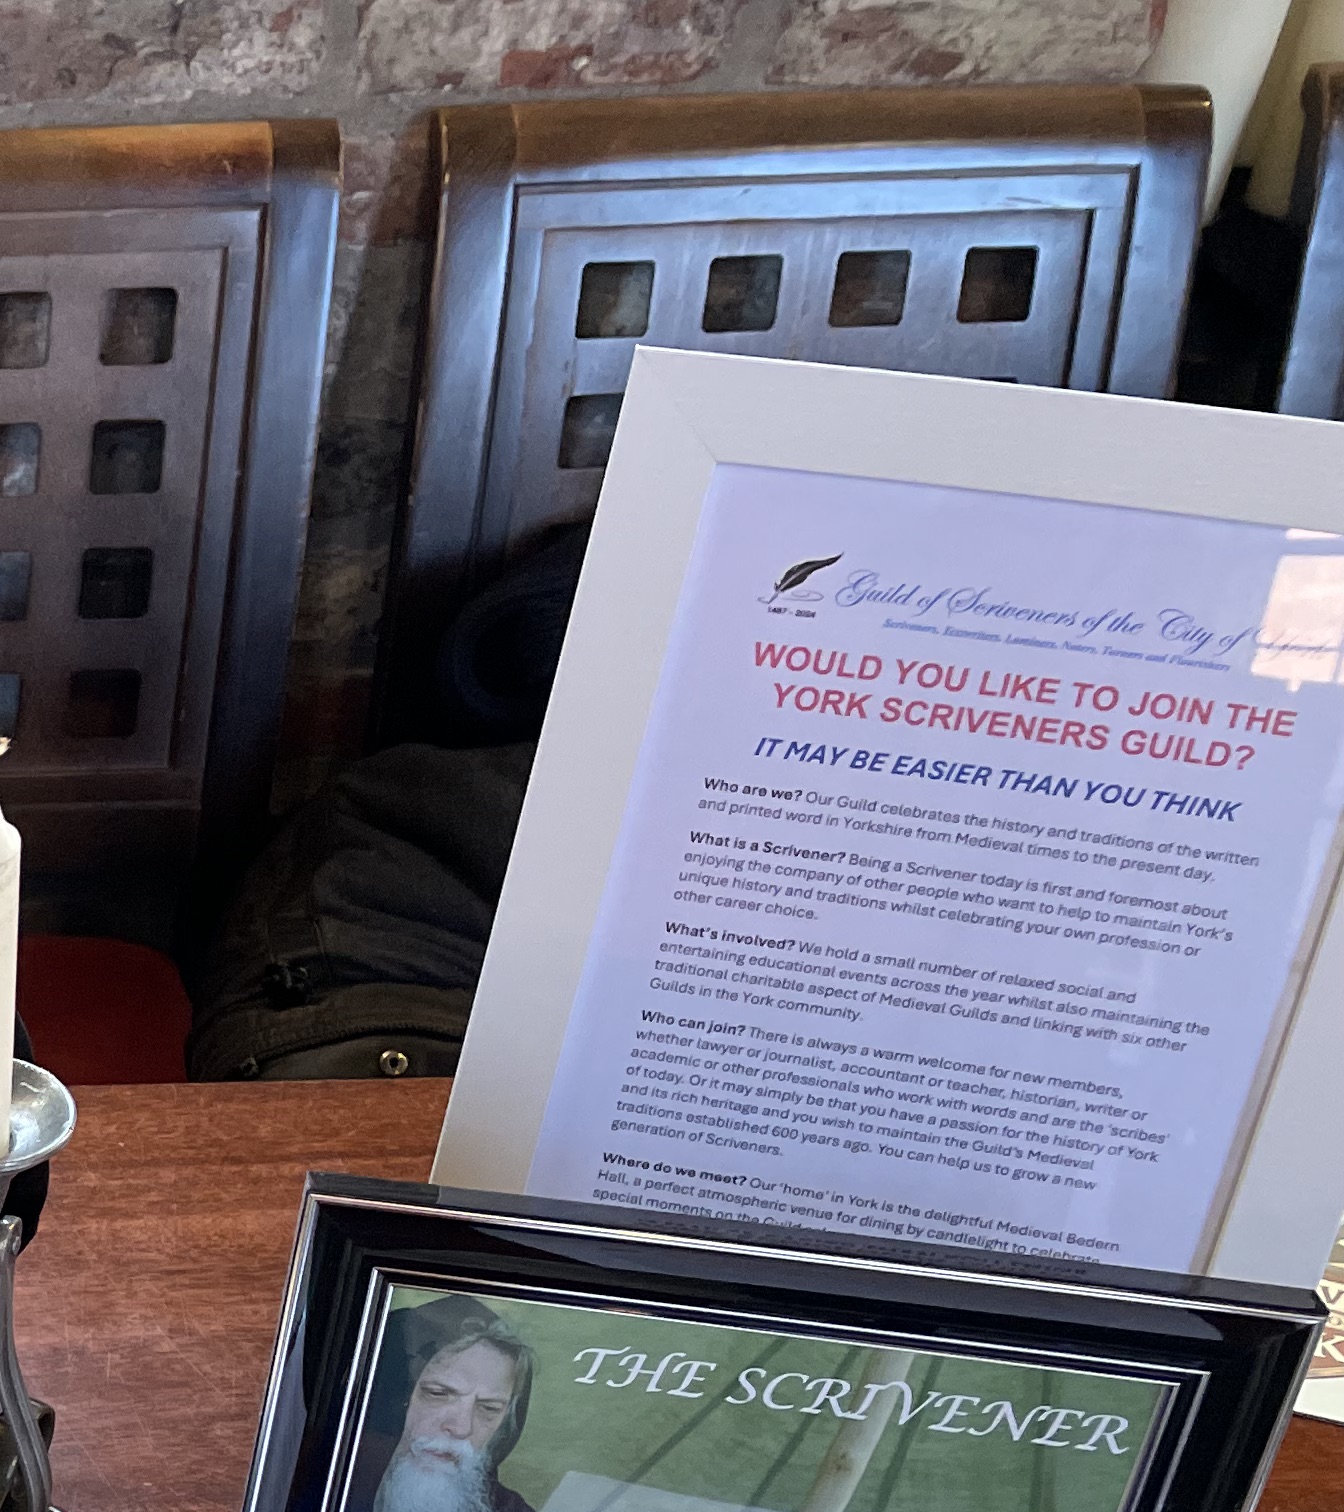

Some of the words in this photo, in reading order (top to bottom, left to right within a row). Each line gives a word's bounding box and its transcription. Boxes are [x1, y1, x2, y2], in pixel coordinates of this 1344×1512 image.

[835, 569, 912, 607] Guild
[912, 589, 950, 616] of
[947, 587, 1077, 627] Scriveners
[1078, 609, 1112, 638] of
[1109, 611, 1143, 636] the
[1158, 608, 1214, 655] City
[1214, 628, 1253, 656] of
[754, 641, 883, 681] WOULD
[896, 658, 970, 693] YOU
[978, 670, 1061, 705] LIKE
[1072, 681, 1120, 712] TO
[1127, 691, 1215, 726] JOIN
[1226, 702, 1298, 737] THE
[773, 682, 873, 719] YORK
[879, 696, 1111, 751] SCRIVENERS
[1120, 729, 1256, 771] GUILD?
[753, 736, 783, 758] IT
[784, 741, 851, 768] MAY
[849, 749, 886, 773] BE
[890, 755, 992, 788] EASIER
[998, 769, 1080, 798] THAN
[1083, 780, 1148, 808] YOU
[1150, 790, 1243, 822] THINK
[610, 1119, 686, 1140] generation
[687, 1131, 705, 1142] of
[705, 1132, 783, 1157] Scriveners.
[573, 1345, 717, 1399] THE
[724, 1367, 1130, 1455] SCRIVENER
